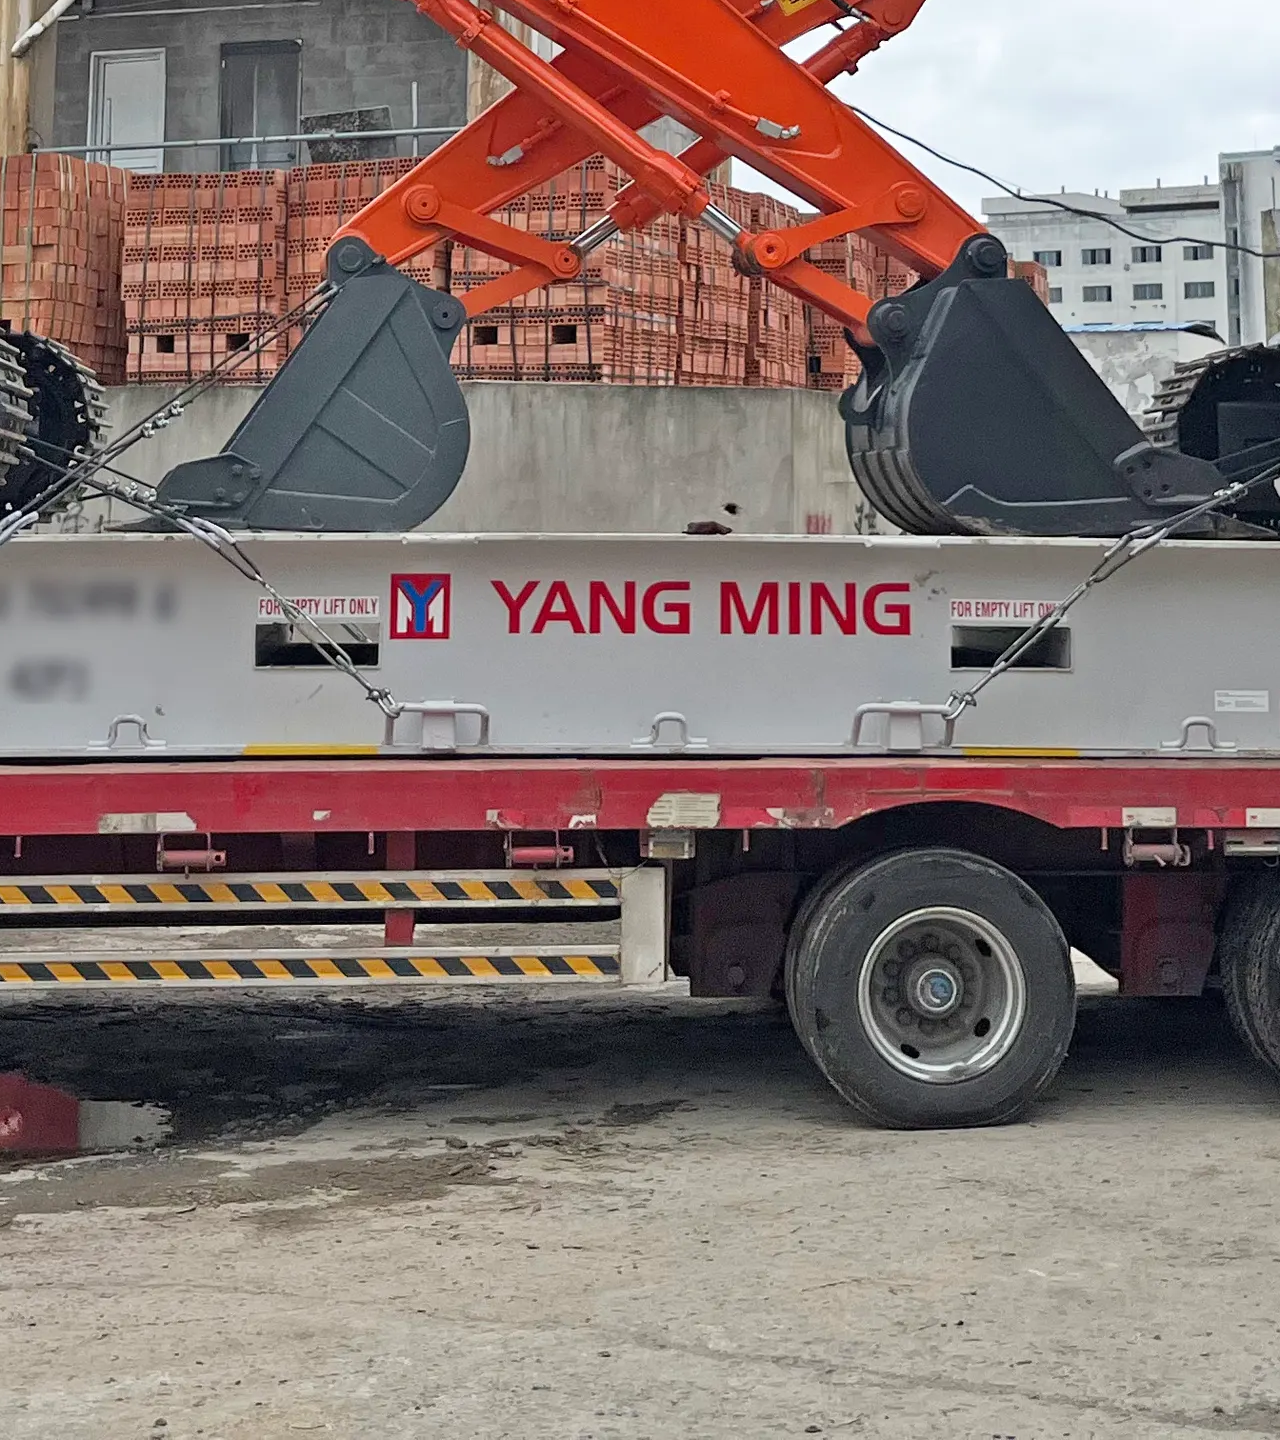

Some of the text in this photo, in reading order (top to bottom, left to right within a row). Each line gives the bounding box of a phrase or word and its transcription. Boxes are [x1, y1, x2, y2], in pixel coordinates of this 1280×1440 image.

[259, 598, 280, 615] FOR
[323, 598, 346, 615] LIFT
[349, 598, 378, 615] ONLY
[490, 580, 911, 636] YANG MING
[951, 601, 973, 617] FOR
[975, 601, 1010, 617] EMPTY
[1013, 602, 1035, 618] LIFT
